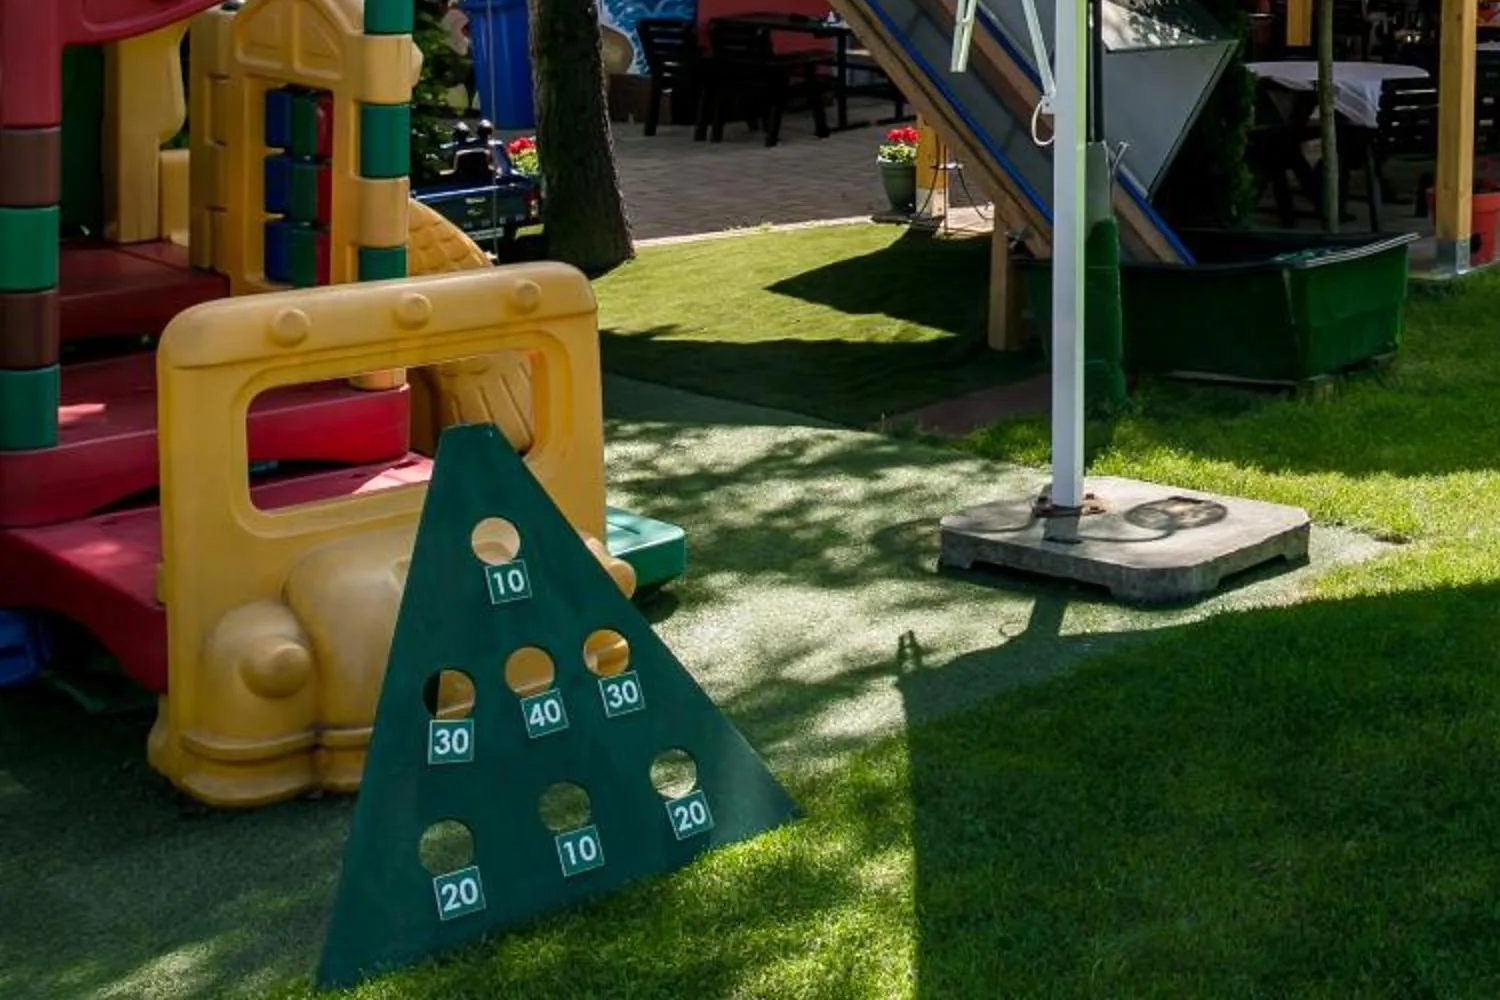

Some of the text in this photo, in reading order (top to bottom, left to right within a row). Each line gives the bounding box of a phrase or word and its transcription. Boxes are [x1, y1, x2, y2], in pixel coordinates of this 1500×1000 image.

[493, 568, 525, 594] 10
[607, 679, 639, 708] 30
[529, 698, 561, 726] 40
[434, 728, 469, 756] 30
[673, 800, 706, 832] 20
[563, 835, 597, 865] 10
[440, 878, 478, 911] 20
